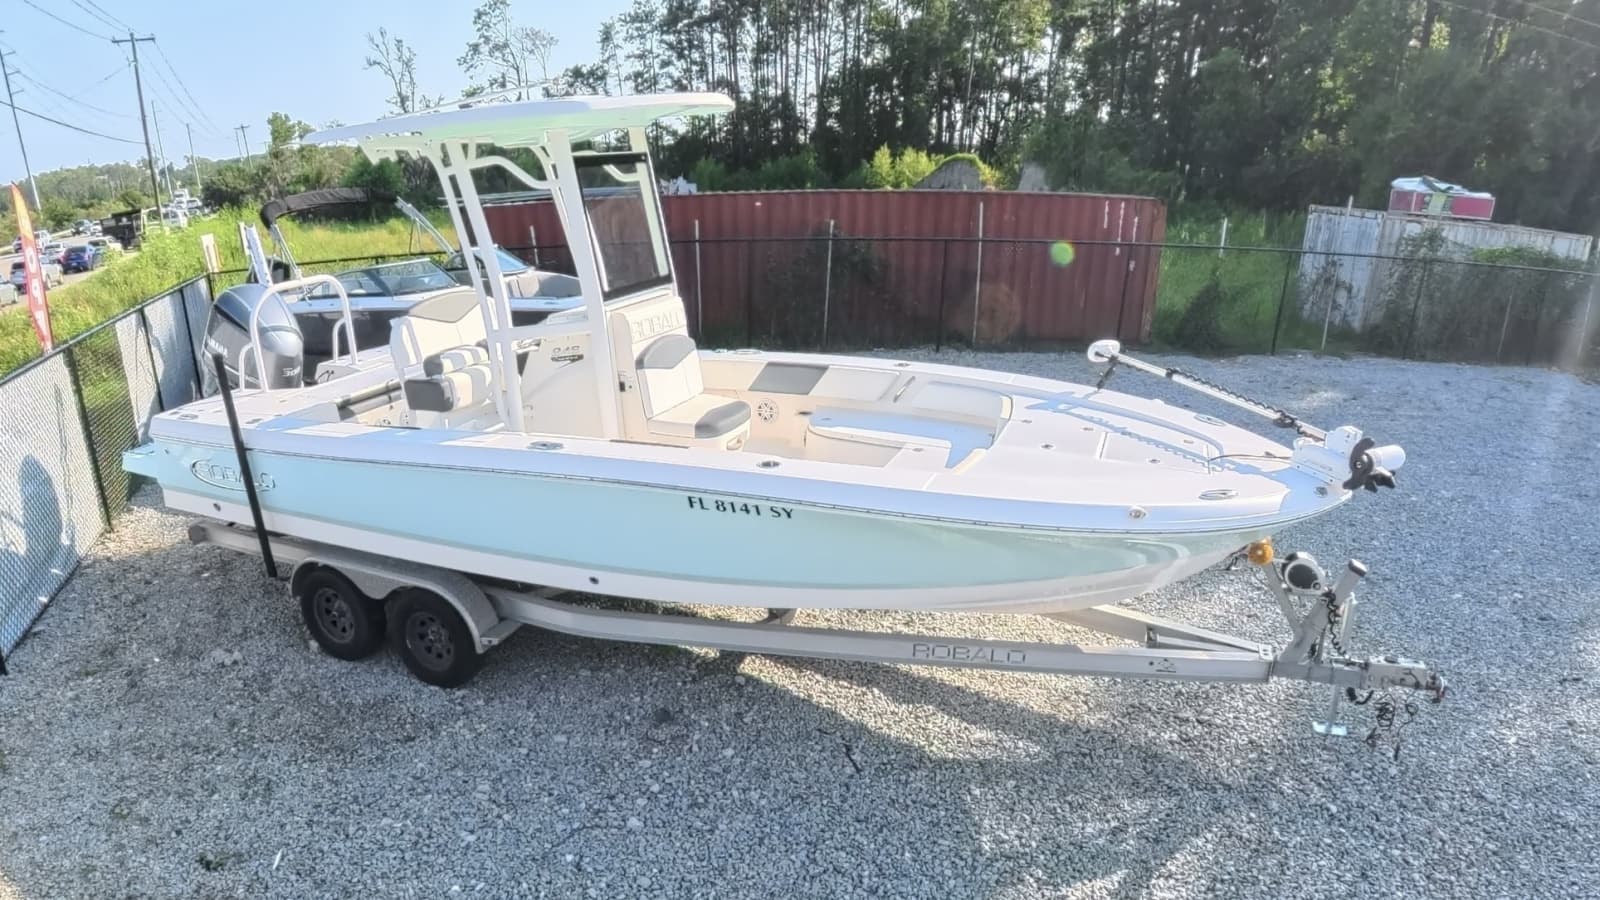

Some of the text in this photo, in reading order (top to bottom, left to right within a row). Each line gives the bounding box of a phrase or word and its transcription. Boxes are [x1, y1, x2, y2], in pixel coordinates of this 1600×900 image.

[197, 461, 276, 489] ROBO
[687, 496, 793, 519] FL 8141 SY
[912, 643, 1026, 664] ROBALO
